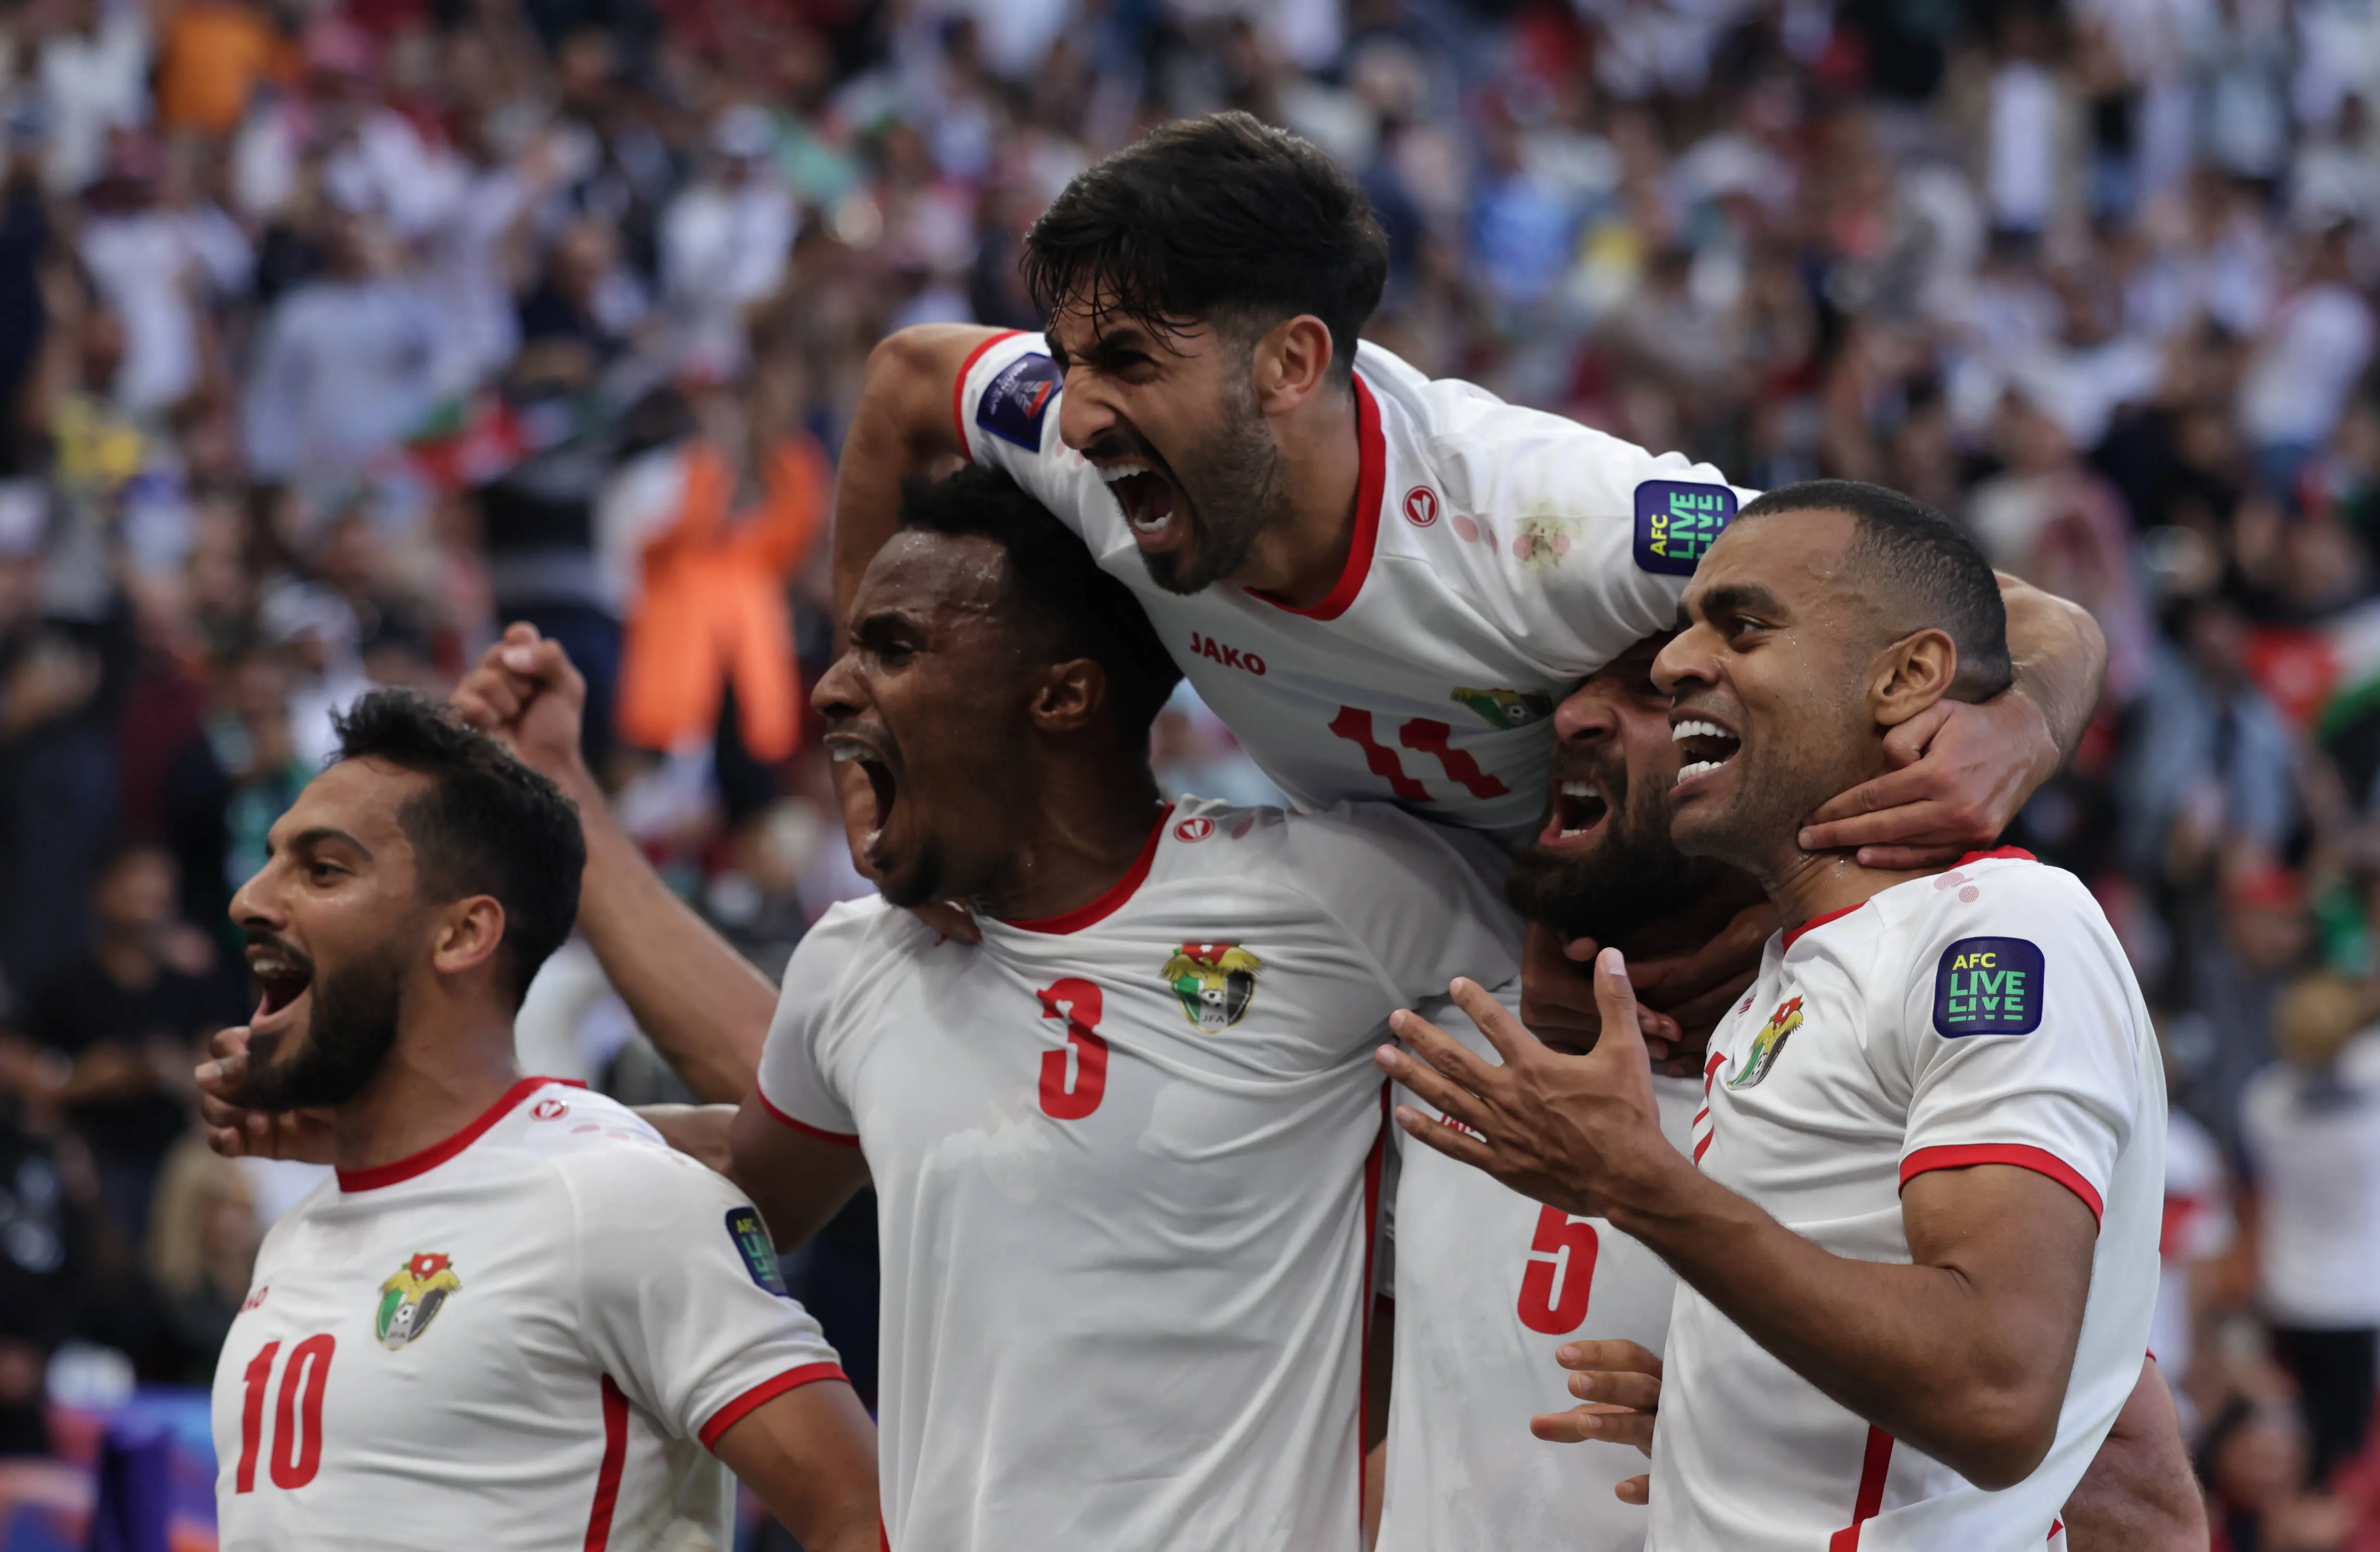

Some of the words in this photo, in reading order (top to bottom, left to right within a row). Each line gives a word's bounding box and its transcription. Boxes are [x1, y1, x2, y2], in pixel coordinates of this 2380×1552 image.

[1650, 514, 1668, 556] AFC
[1669, 492, 1696, 559] LIVE
[1191, 631, 1266, 676] JAKO
[1327, 705, 1512, 802] 11
[1950, 971, 2025, 997] LIVE
[1952, 953, 1996, 971] AFC
[1201, 1014, 1225, 1023] JFA
[1037, 977, 1108, 1120] 3
[1517, 1203, 1599, 1335] 5
[235, 1333, 336, 1495] 10
